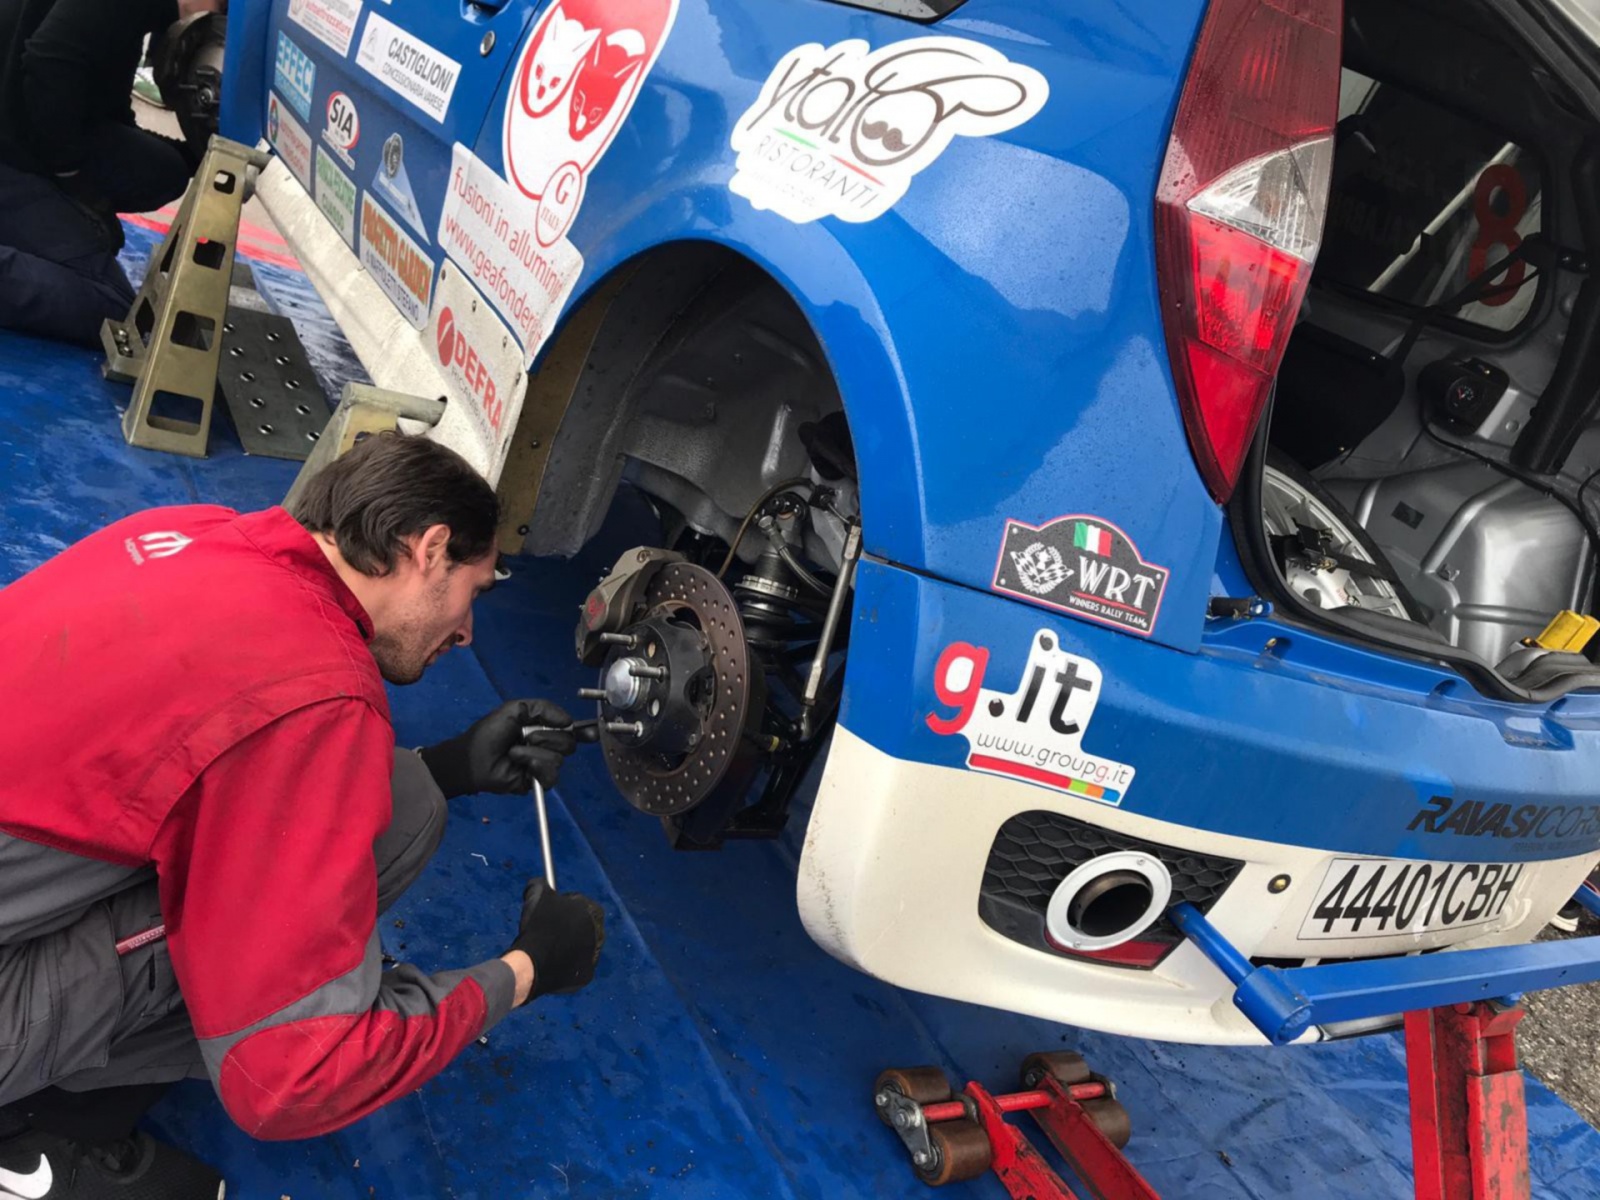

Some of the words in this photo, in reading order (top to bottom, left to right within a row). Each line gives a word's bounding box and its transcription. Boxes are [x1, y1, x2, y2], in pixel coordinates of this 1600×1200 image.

[388, 36, 454, 94] CASTIGLIONI
[330, 97, 353, 140] SIA
[555, 171, 576, 205] G
[753, 134, 880, 209] RISTORANTI
[453, 166, 497, 227] fusioni
[494, 208, 509, 242] in
[454, 330, 502, 438] DEFRA
[1069, 594, 1100, 612] WINNERS
[1100, 604, 1124, 619] RALLY
[1078, 555, 1156, 609] WRT
[977, 731, 1130, 786] www.groupg.it
[1406, 795, 1600, 838] RAVASICOR
[1312, 863, 1524, 933] 44401CBH
